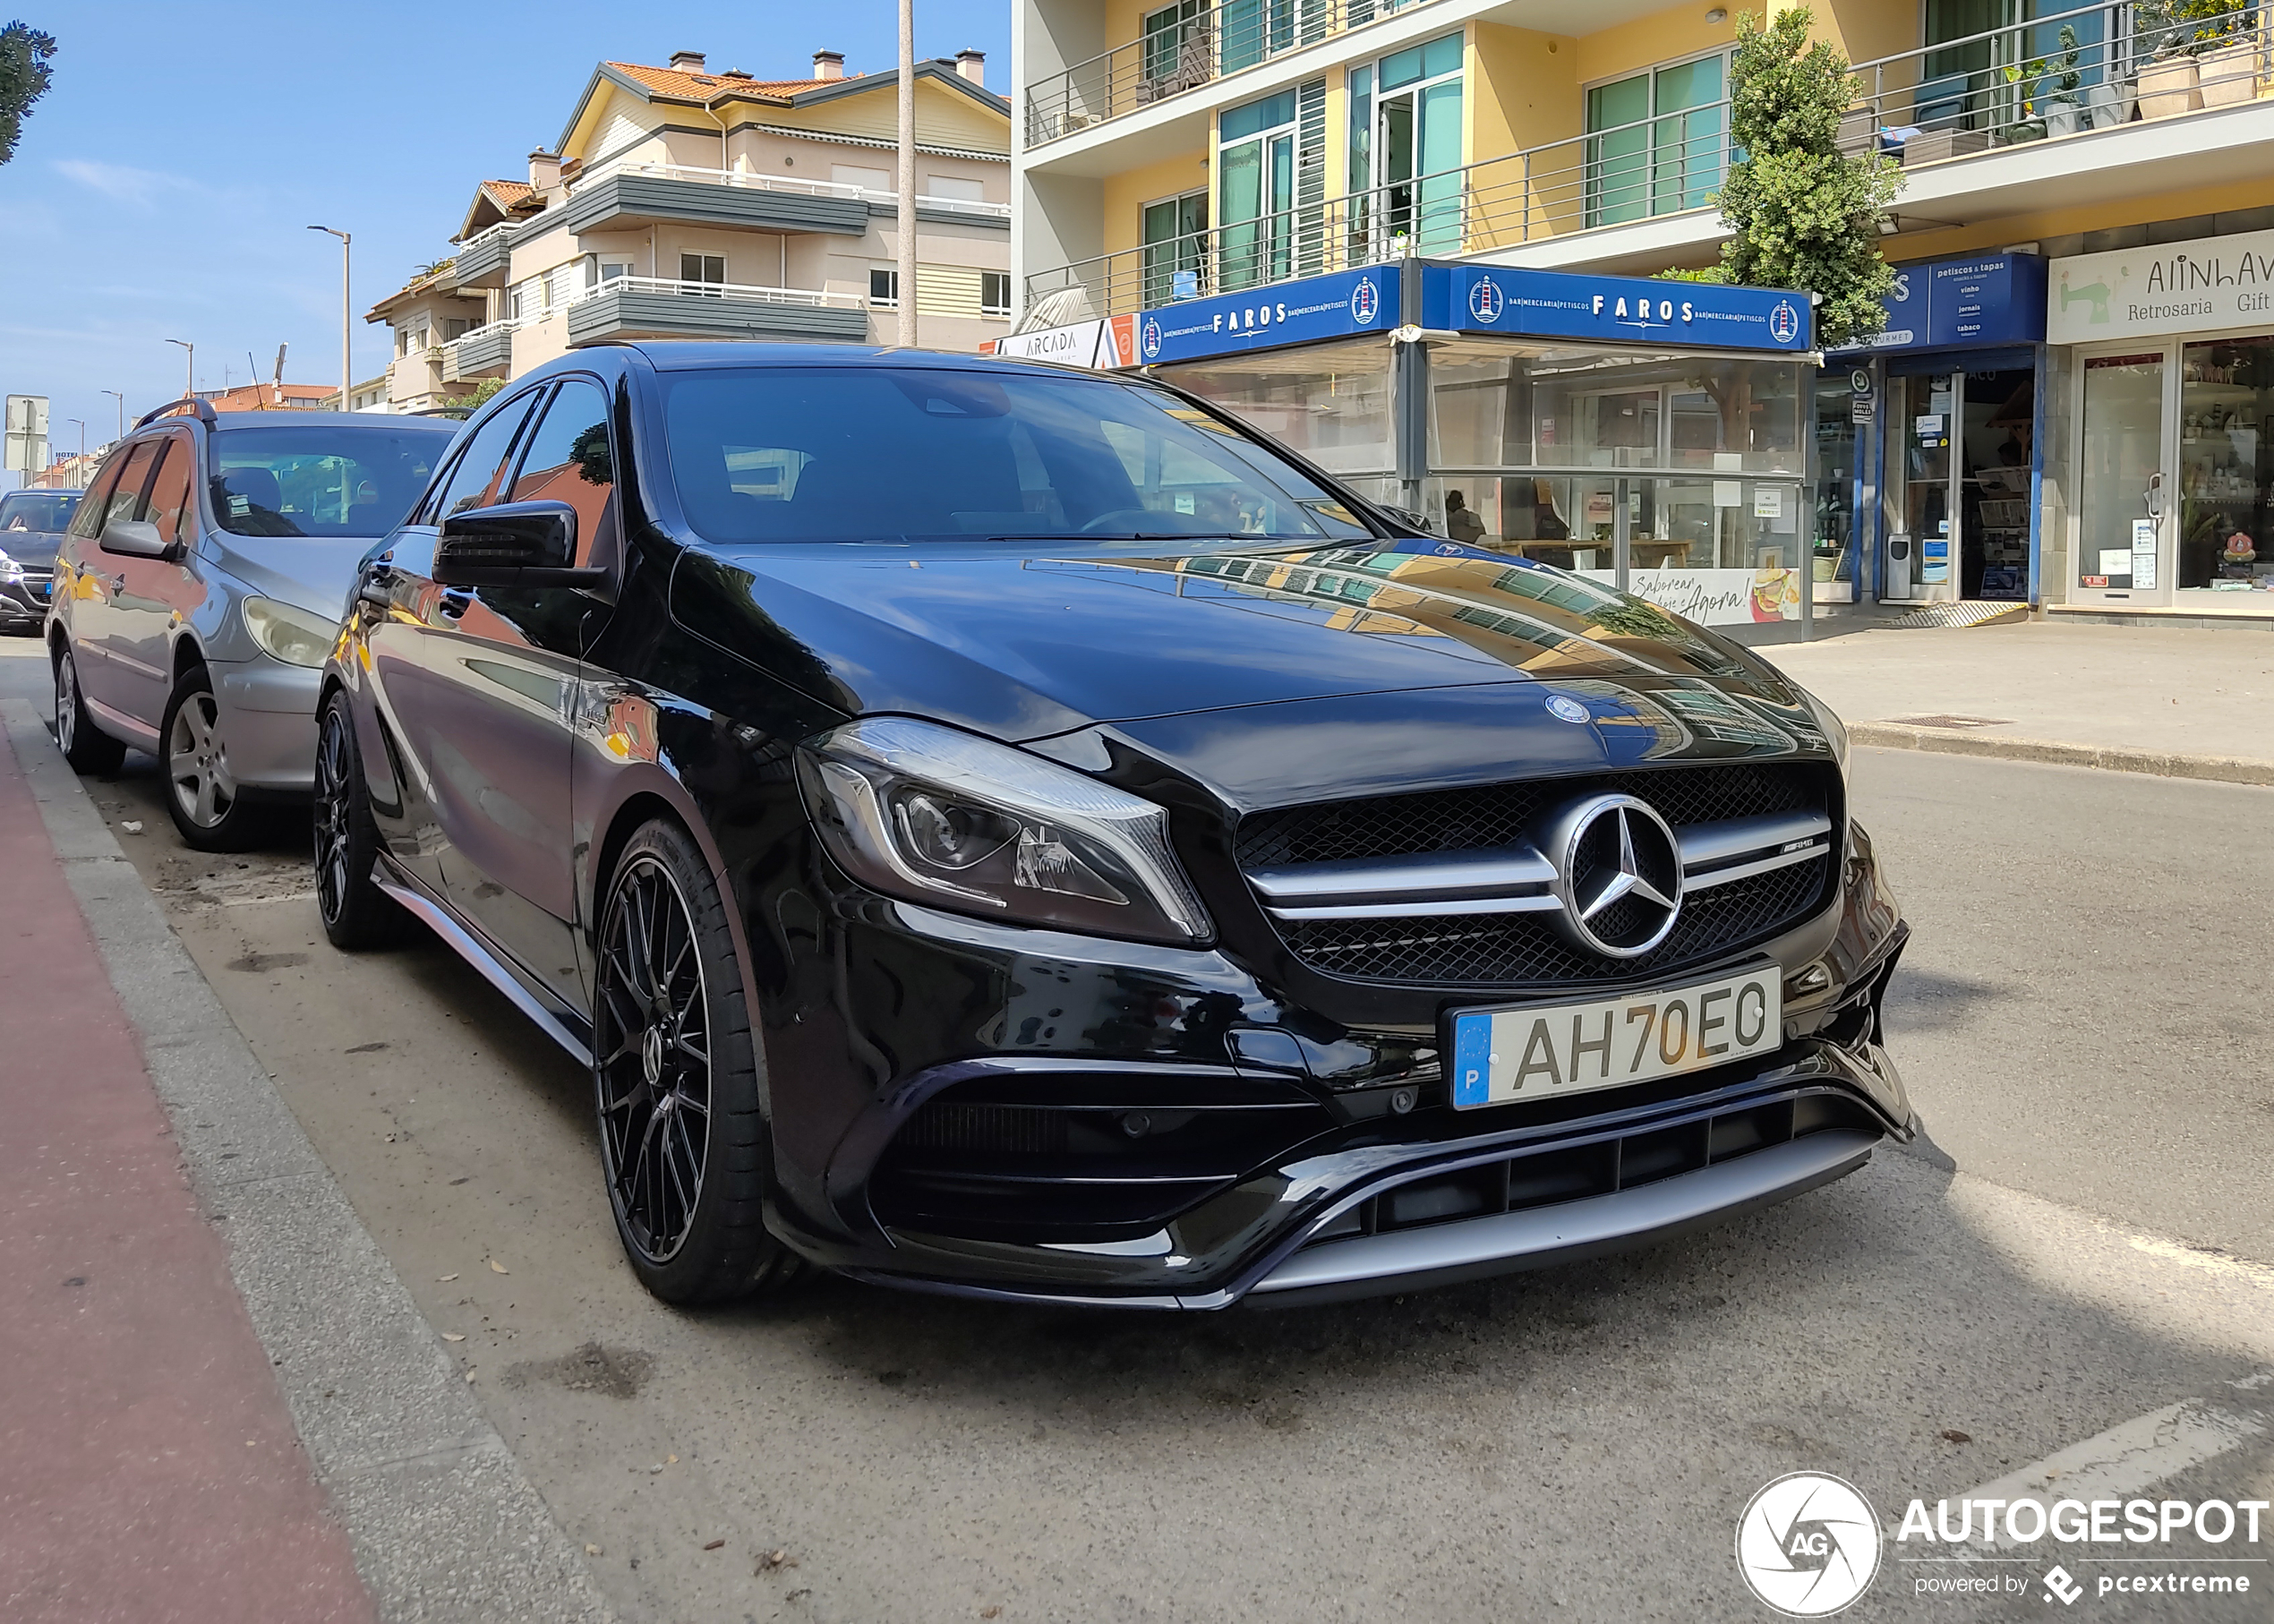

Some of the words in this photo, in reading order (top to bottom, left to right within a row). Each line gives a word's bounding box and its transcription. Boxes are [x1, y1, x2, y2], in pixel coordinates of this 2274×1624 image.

[1937, 266, 1972, 278] petiscos
[1980, 261, 2005, 272] tapas
[1961, 286, 1980, 294] vinho
[1213, 303, 1287, 333] FAROS
[1593, 295, 1693, 321] FAROS
[1958, 304, 1980, 313] jornais
[2128, 298, 2213, 321] Retrosaria
[2237, 292, 2270, 312] Gift
[1957, 324, 1981, 332] tabaco
[1026, 331, 1077, 356] ARCADA
[1631, 573, 1695, 598] Saborear
[1679, 577, 1750, 626] Agora!
[1466, 1070, 1479, 1090] P
